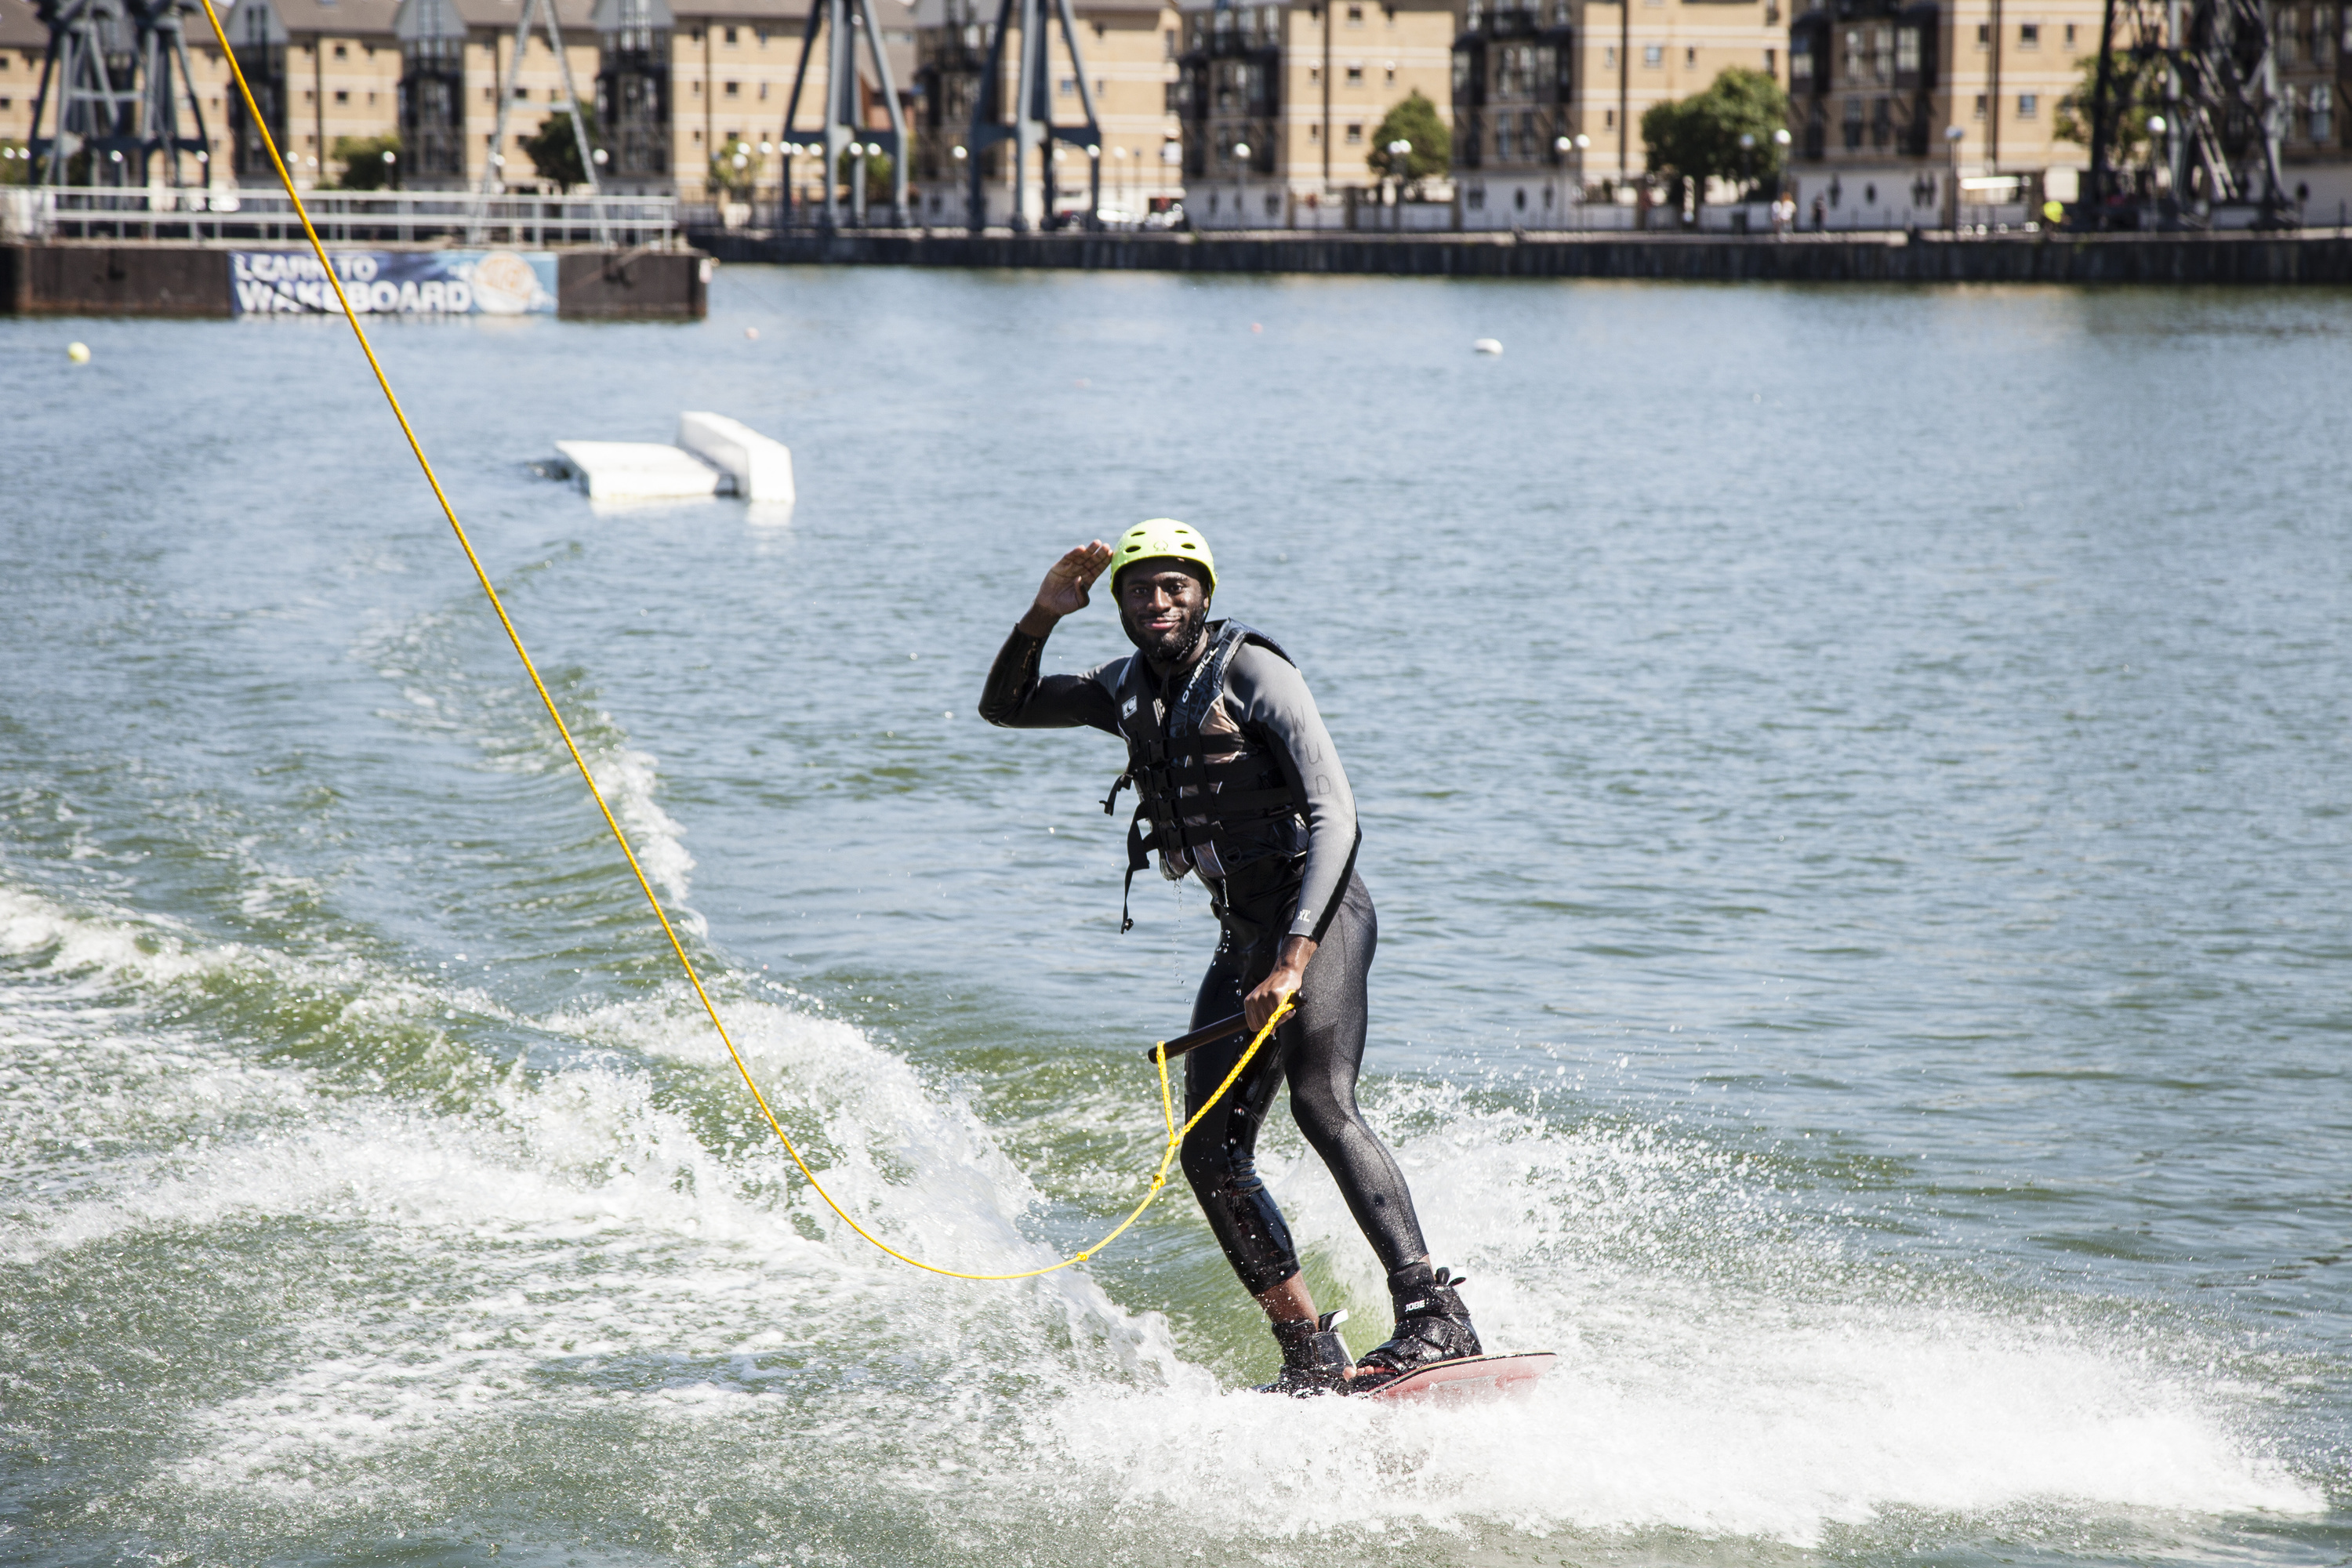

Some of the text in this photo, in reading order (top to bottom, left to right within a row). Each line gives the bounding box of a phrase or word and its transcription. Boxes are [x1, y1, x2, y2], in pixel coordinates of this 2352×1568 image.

[336, 256, 379, 282] TO
[237, 280, 473, 313] WAKEBOARD
[1405, 1299, 1425, 1312] JOBE
